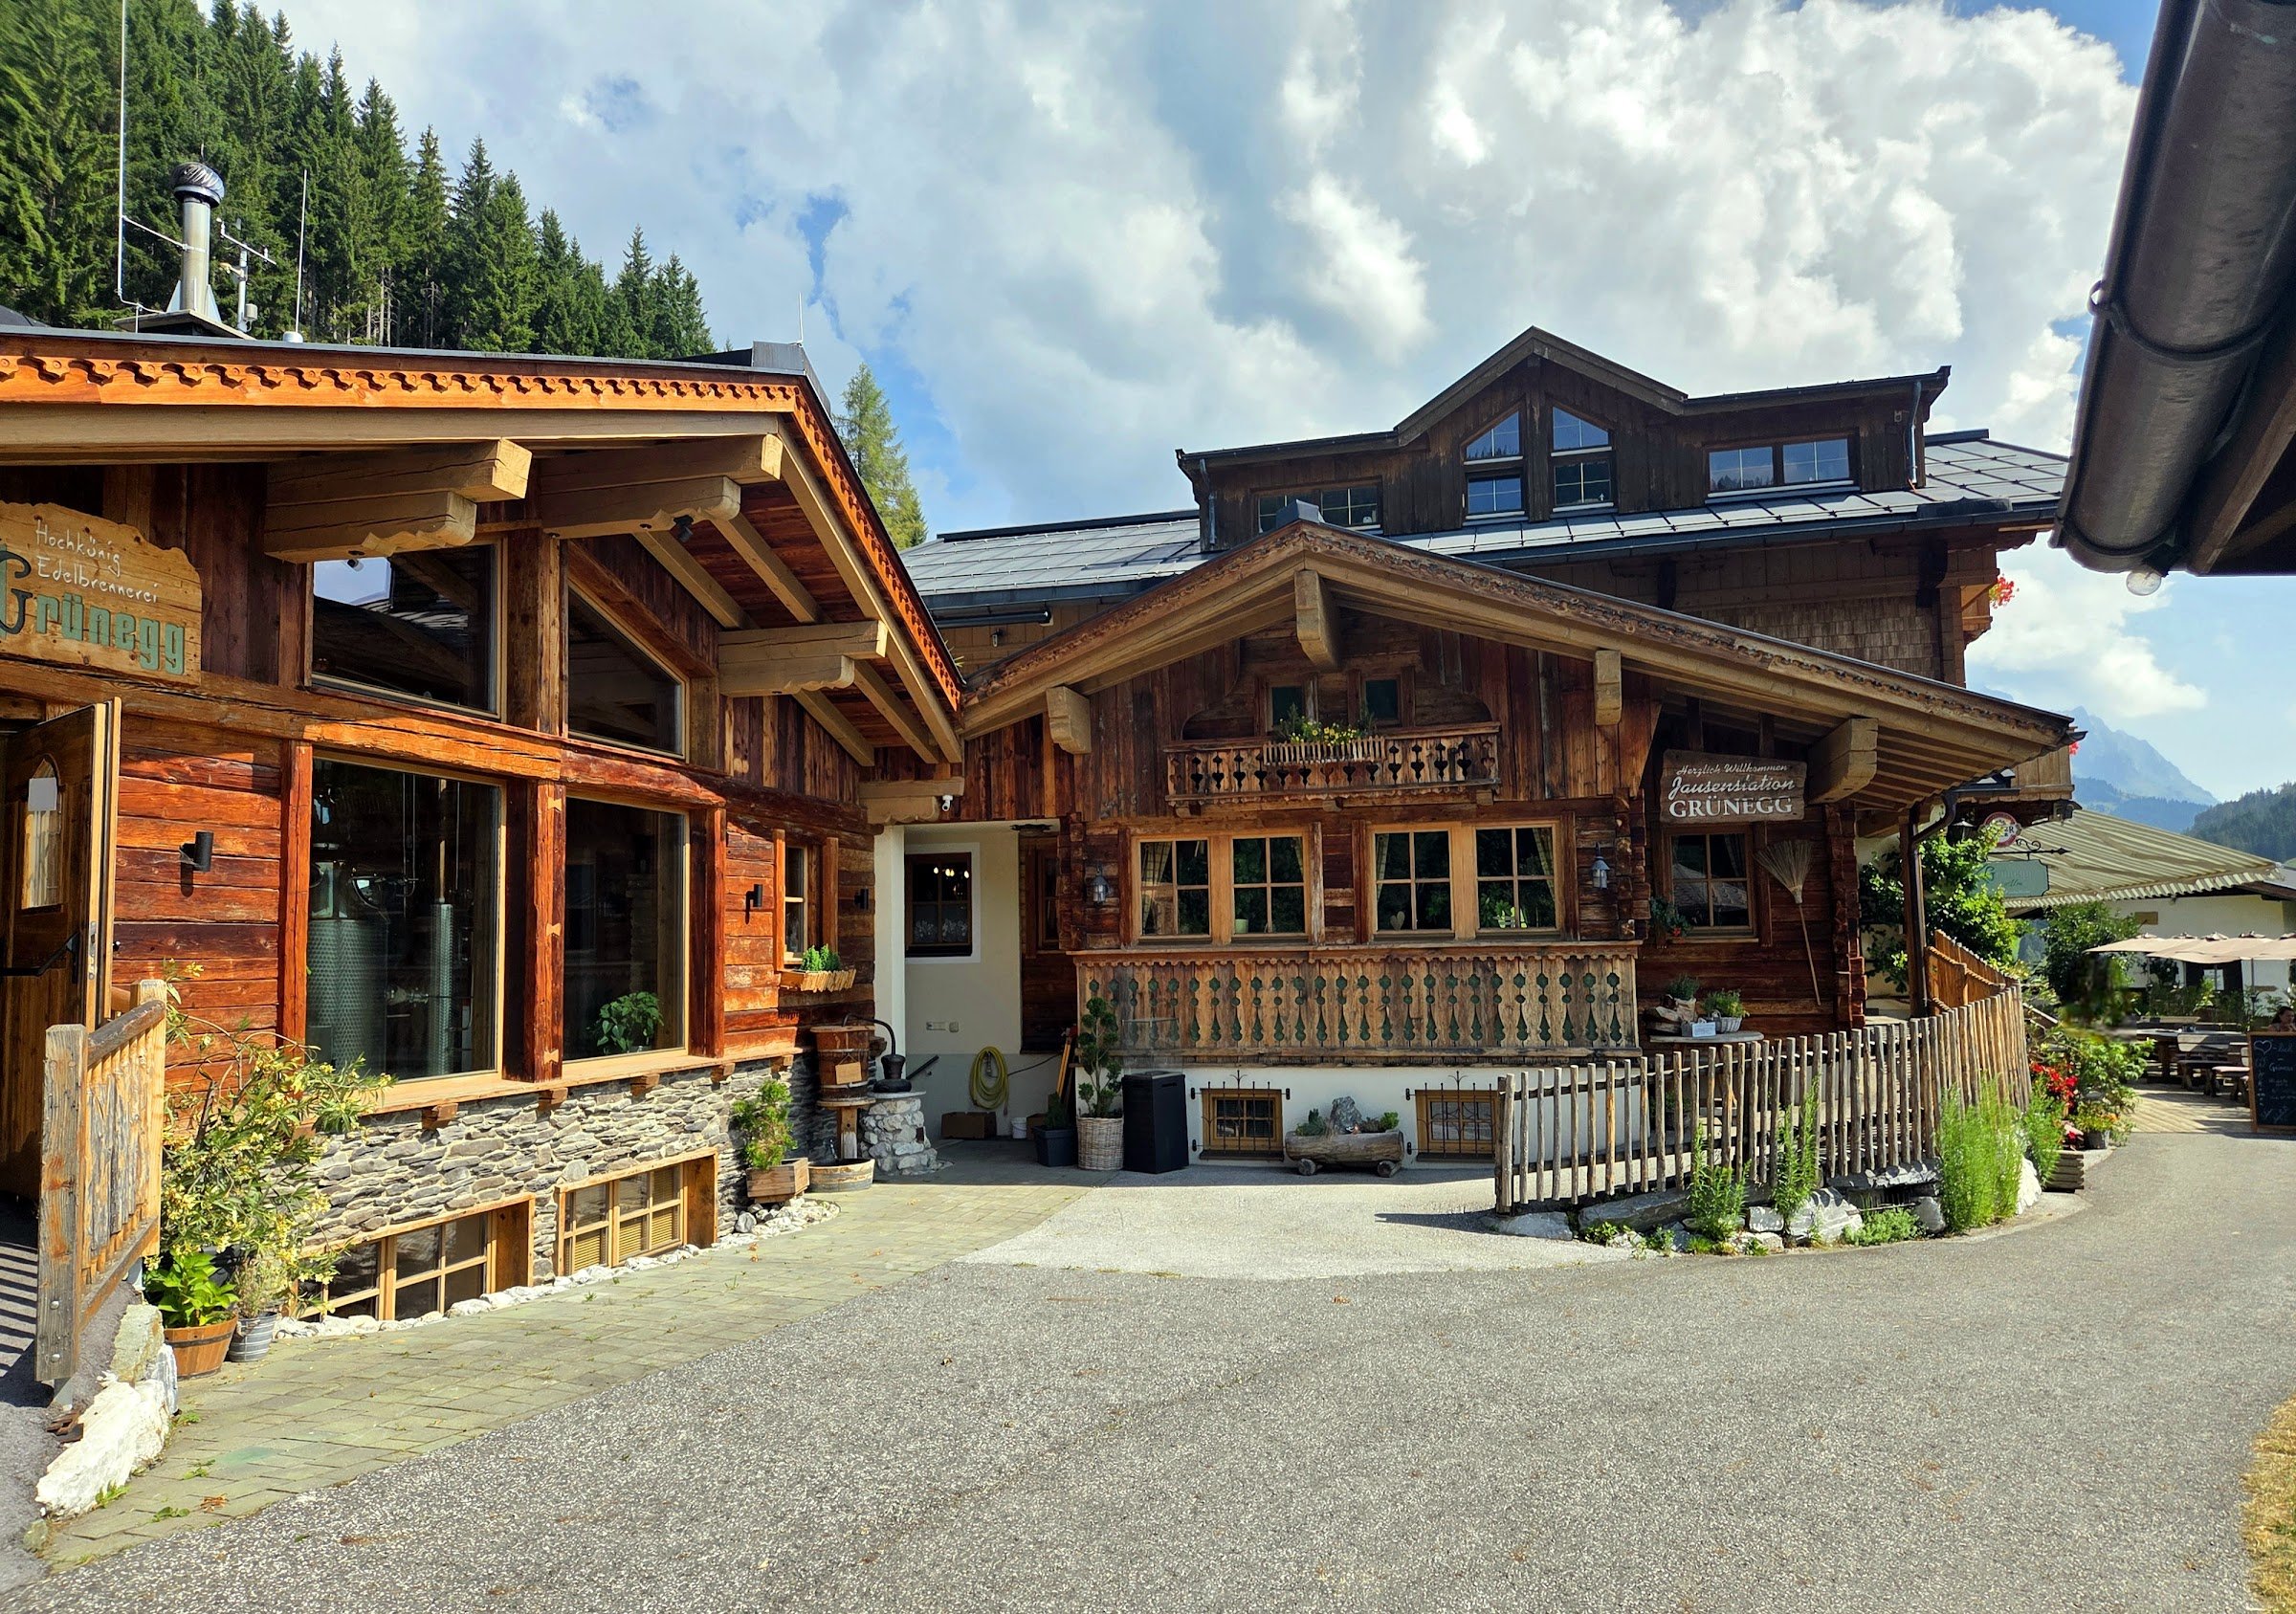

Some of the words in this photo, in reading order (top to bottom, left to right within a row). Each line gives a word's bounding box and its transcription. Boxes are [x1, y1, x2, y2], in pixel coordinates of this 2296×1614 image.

[35, 519, 121, 578] Hochkönig
[36, 555, 158, 603] Edelbrennerei
[1676, 764, 1721, 778] Herzlich
[1724, 763, 1789, 773] Willkommen
[1667, 774, 1795, 801] Jausenstation
[1669, 795, 1793, 818] GRÜNEGG
